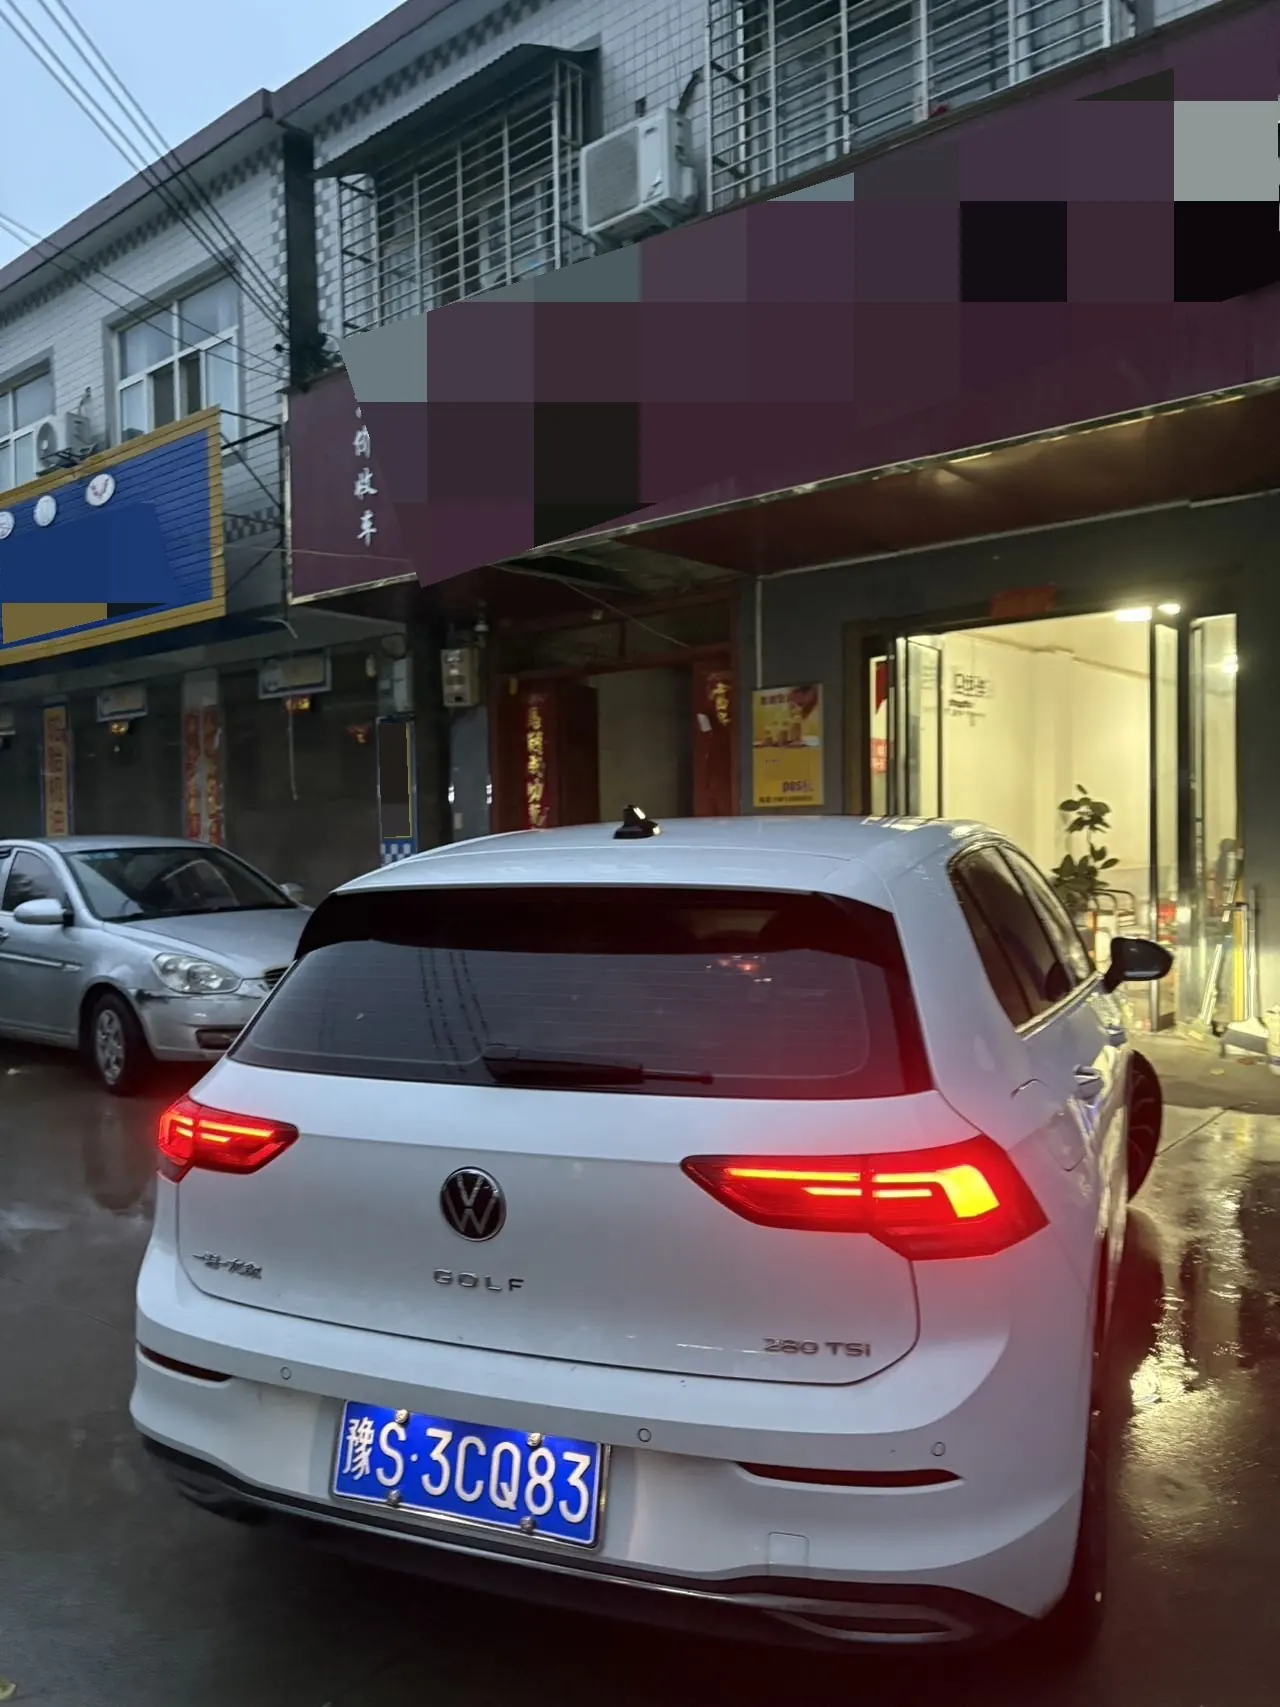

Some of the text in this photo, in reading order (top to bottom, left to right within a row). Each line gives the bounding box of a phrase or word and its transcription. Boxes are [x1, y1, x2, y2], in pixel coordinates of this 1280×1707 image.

[433, 1267, 525, 1293] GOLF
[763, 1336, 872, 1358] 280 TSI
